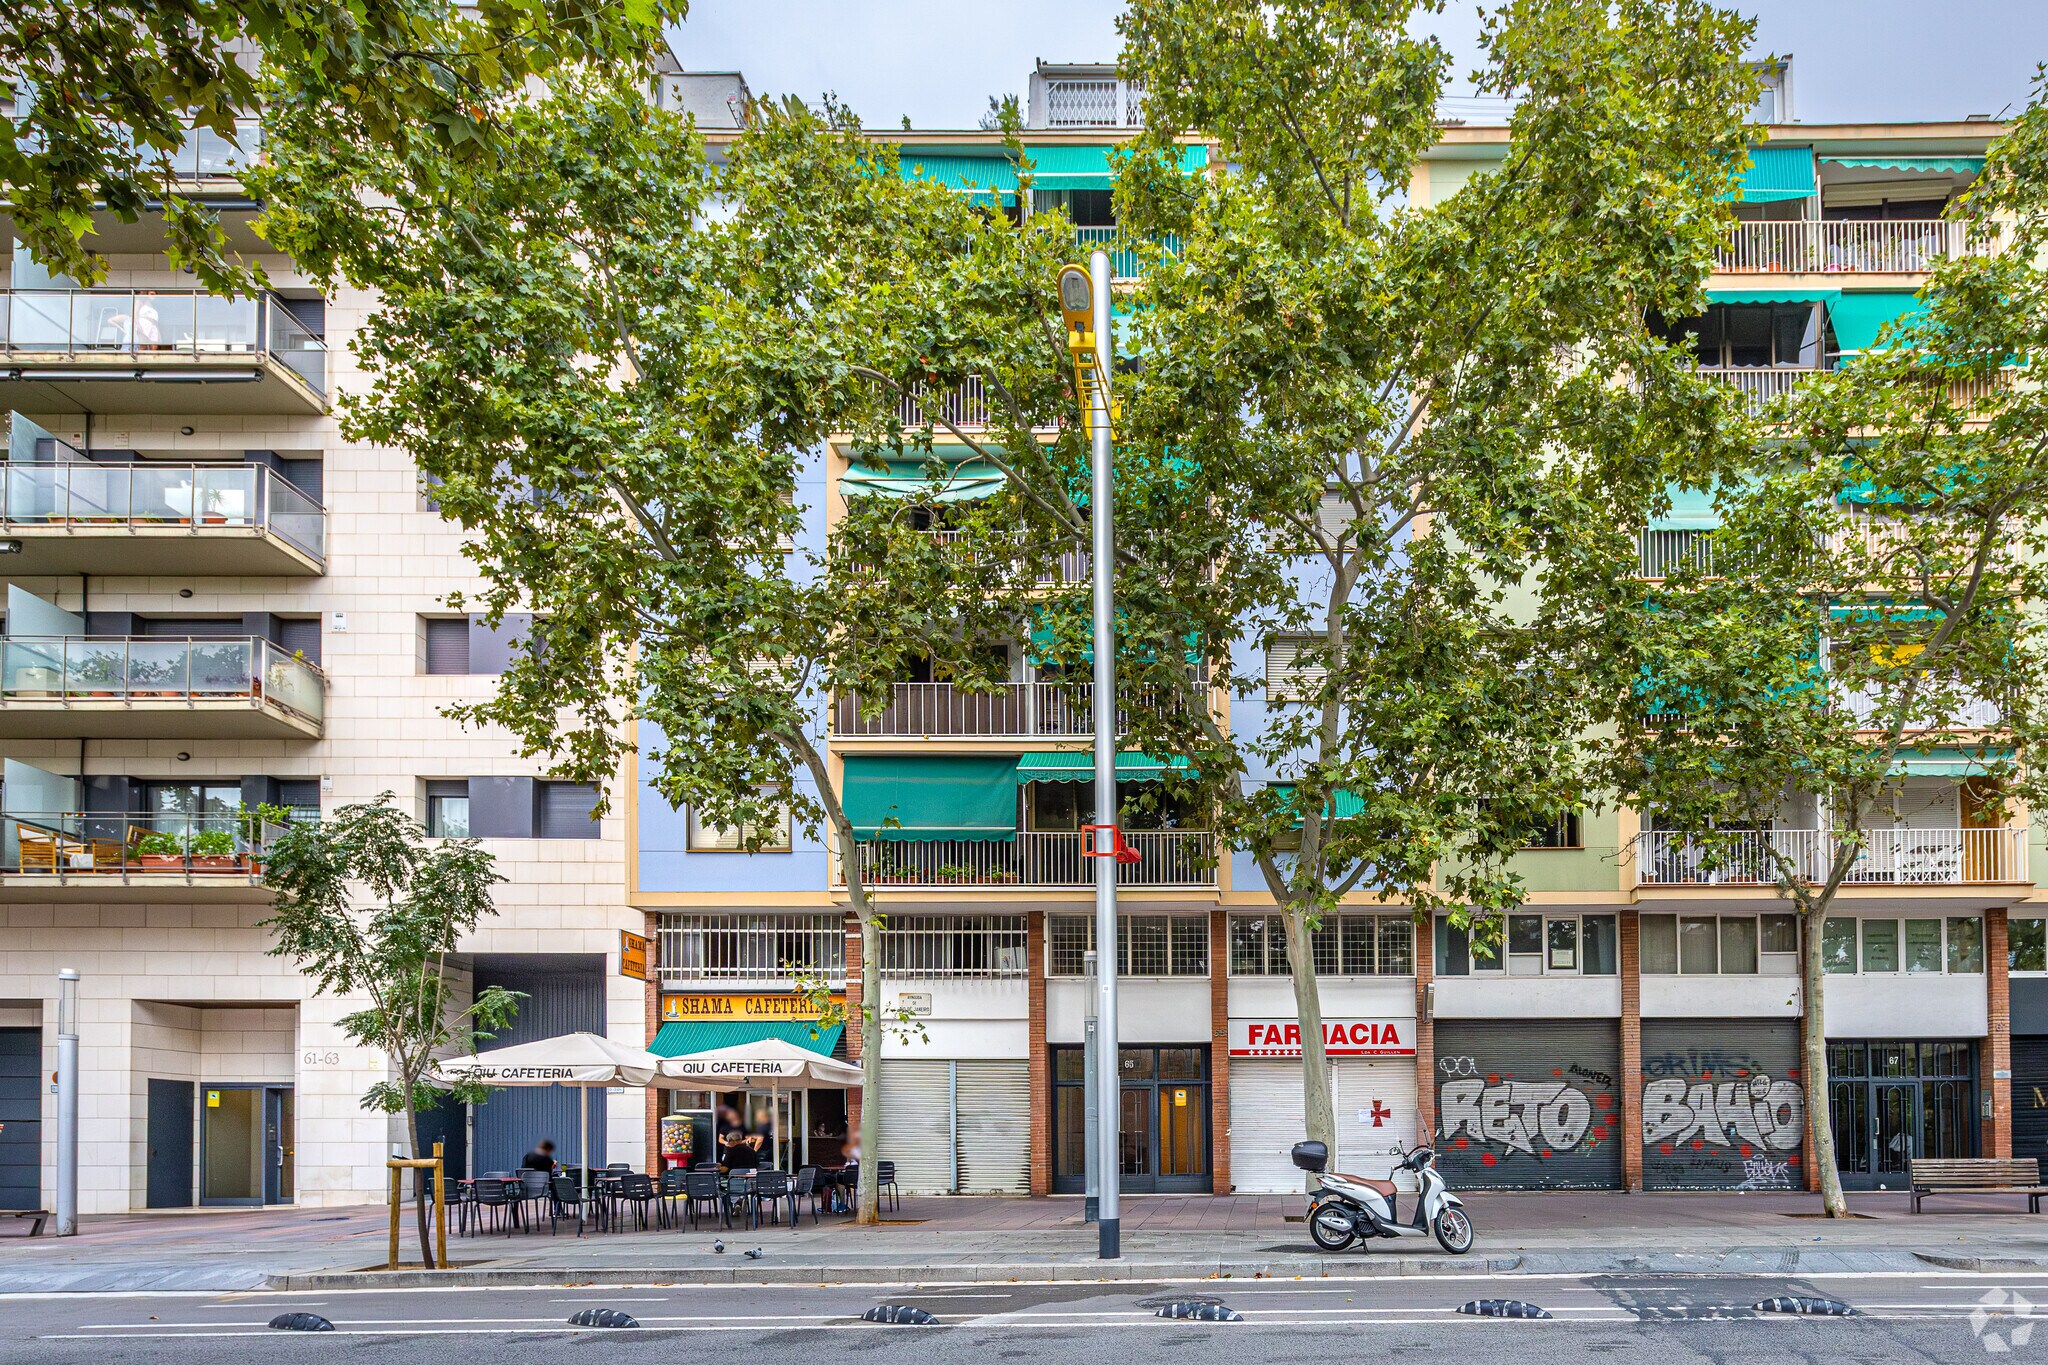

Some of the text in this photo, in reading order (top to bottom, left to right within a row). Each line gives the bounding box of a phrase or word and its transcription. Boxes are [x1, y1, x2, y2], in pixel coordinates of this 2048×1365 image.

[682, 997, 733, 1014] SHAMA
[304, 1052, 340, 1065] 61-63
[1889, 1056, 1899, 1065] 67
[683, 1062, 783, 1073] QIU CAFETERIA
[1124, 1060, 1134, 1069] 65
[501, 1068, 574, 1079] CAFETERIA
